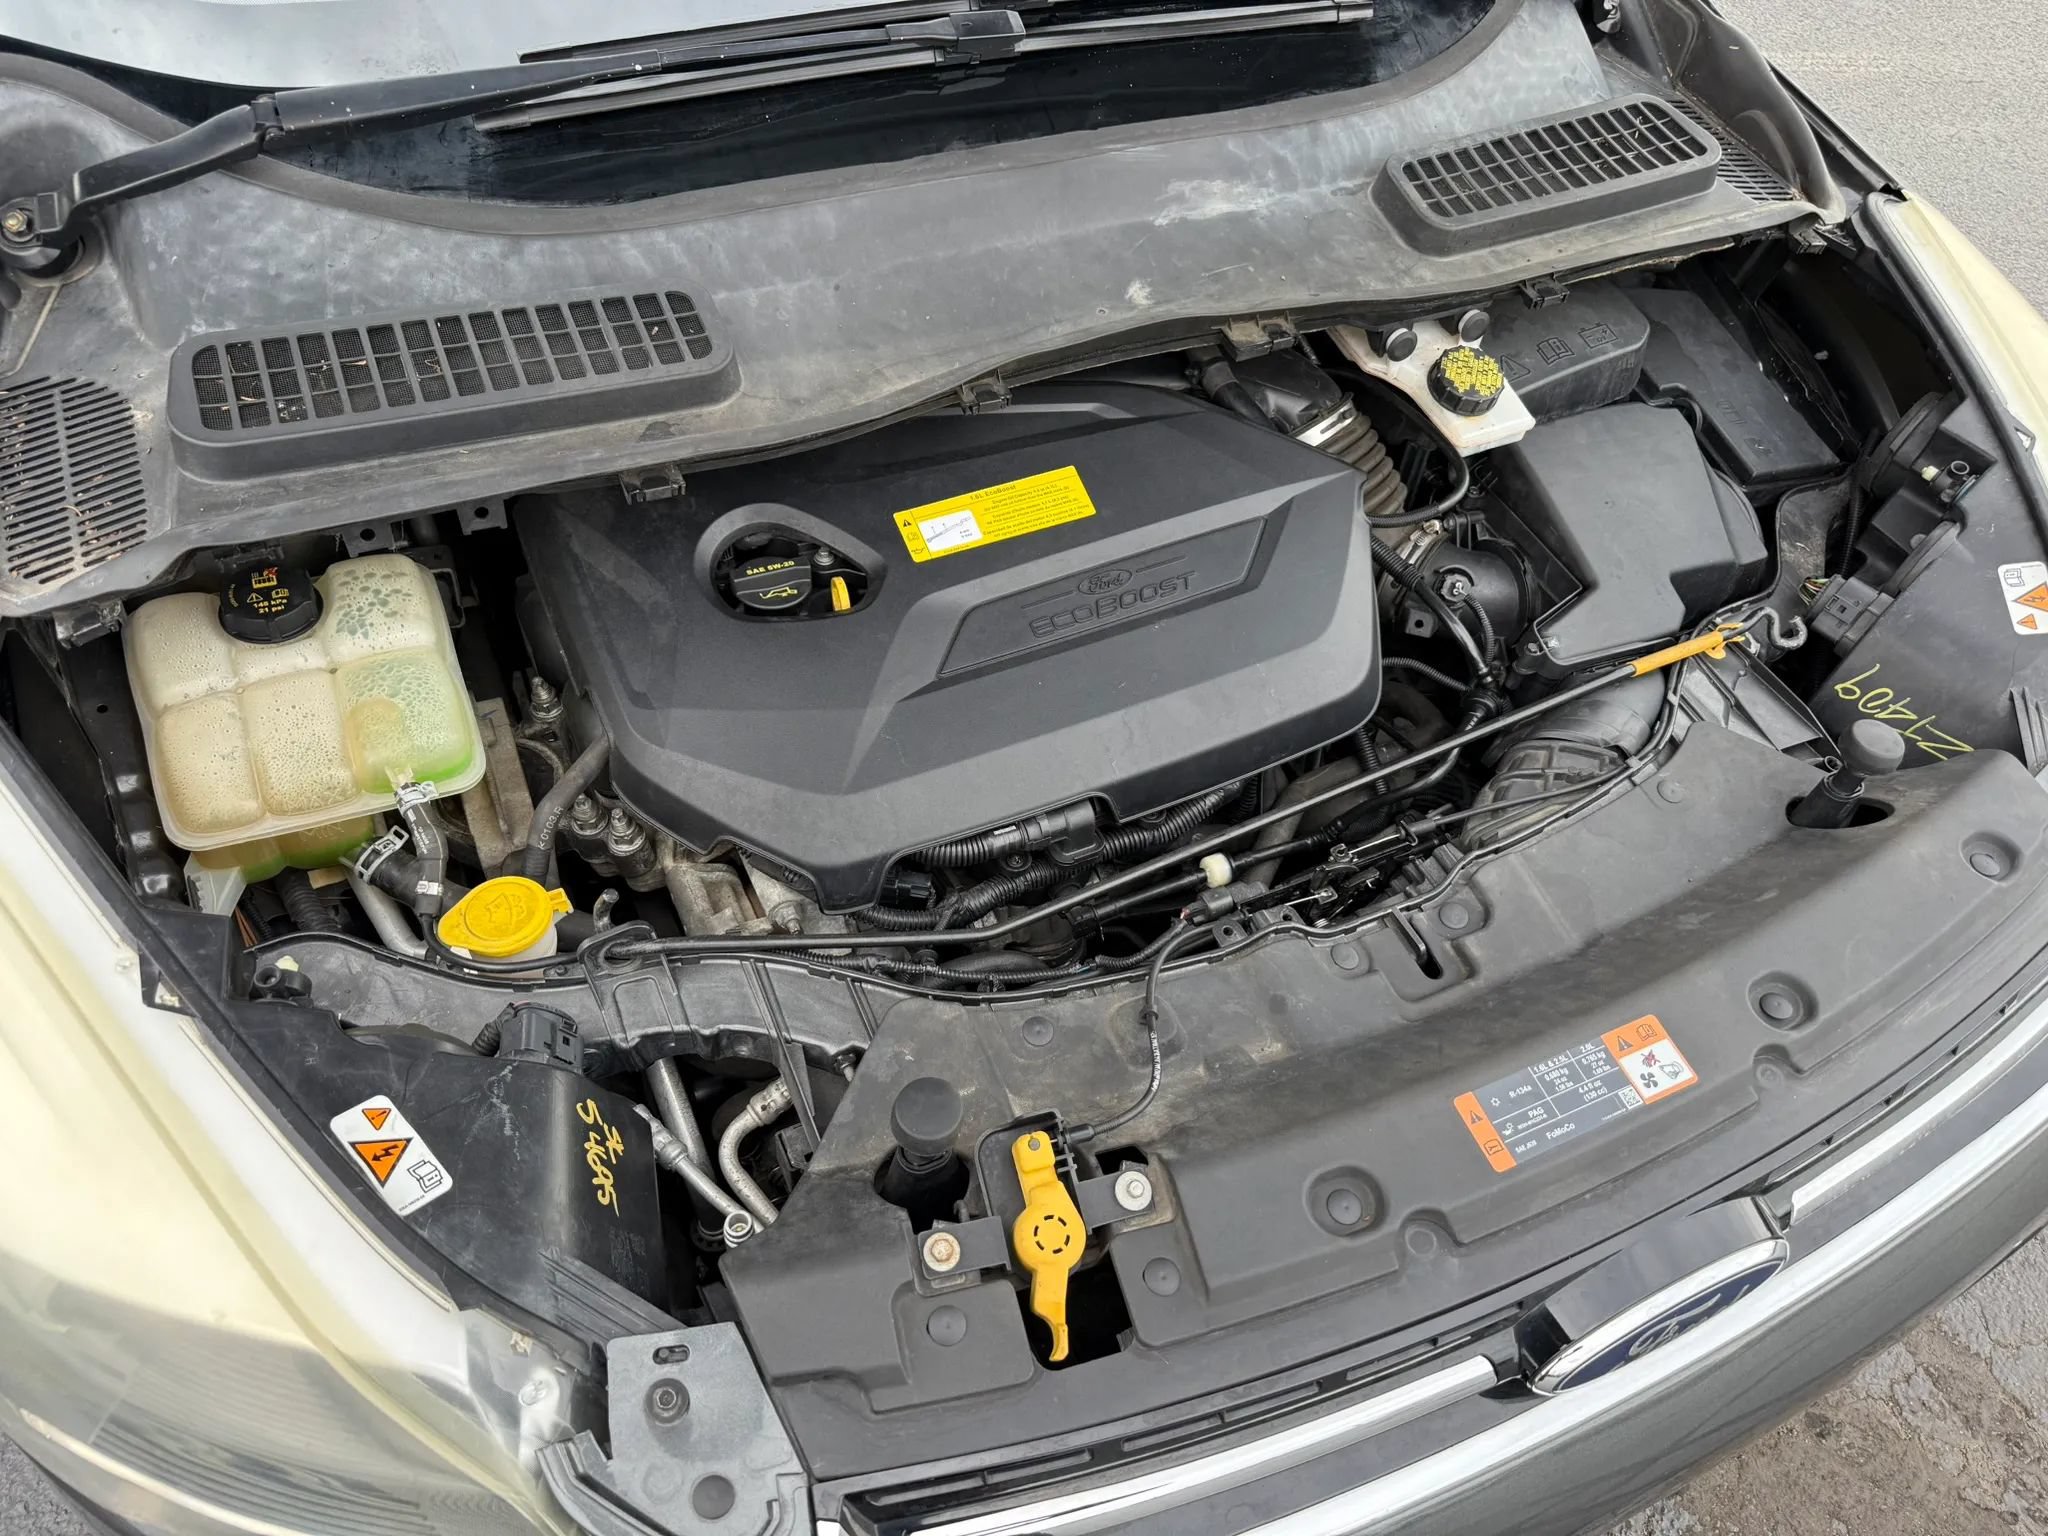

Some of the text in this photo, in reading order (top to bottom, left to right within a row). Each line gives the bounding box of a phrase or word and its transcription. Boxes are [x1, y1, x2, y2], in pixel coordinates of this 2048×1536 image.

[746, 560, 795, 576] SAE 5W-20
[1547, 1060, 1555, 1068] &
[1509, 1084, 1531, 1098] R-134a
[1528, 1107, 1545, 1119] PAG
[1547, 1123, 1575, 1140] FoMoCo
